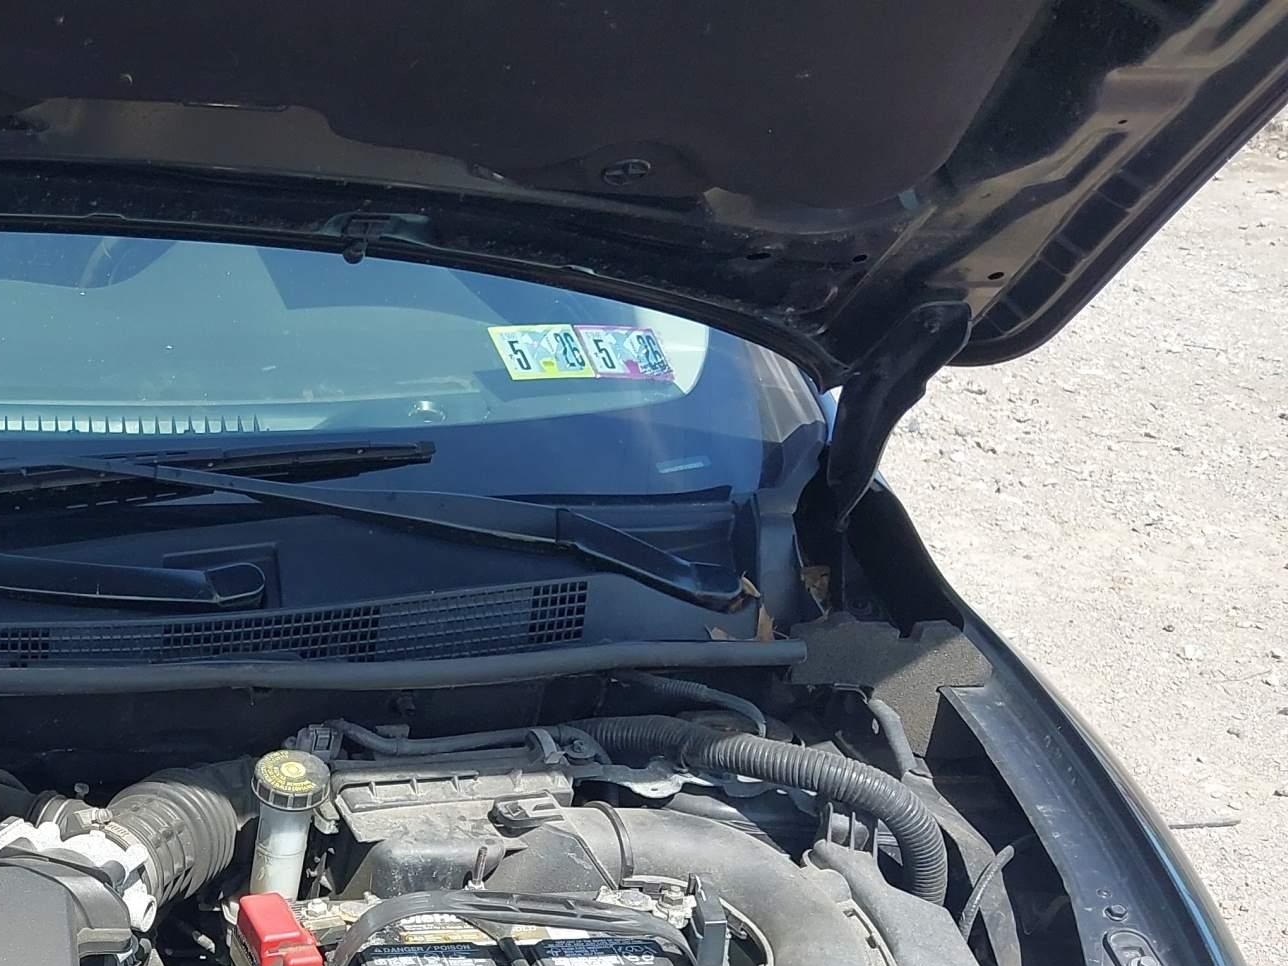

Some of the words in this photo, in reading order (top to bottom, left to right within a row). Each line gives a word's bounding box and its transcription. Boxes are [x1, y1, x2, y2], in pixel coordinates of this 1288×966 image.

[508, 340, 532, 370] 5
[553, 332, 586, 368] 26
[593, 339, 616, 369] 5
[636, 334, 668, 370] 26
